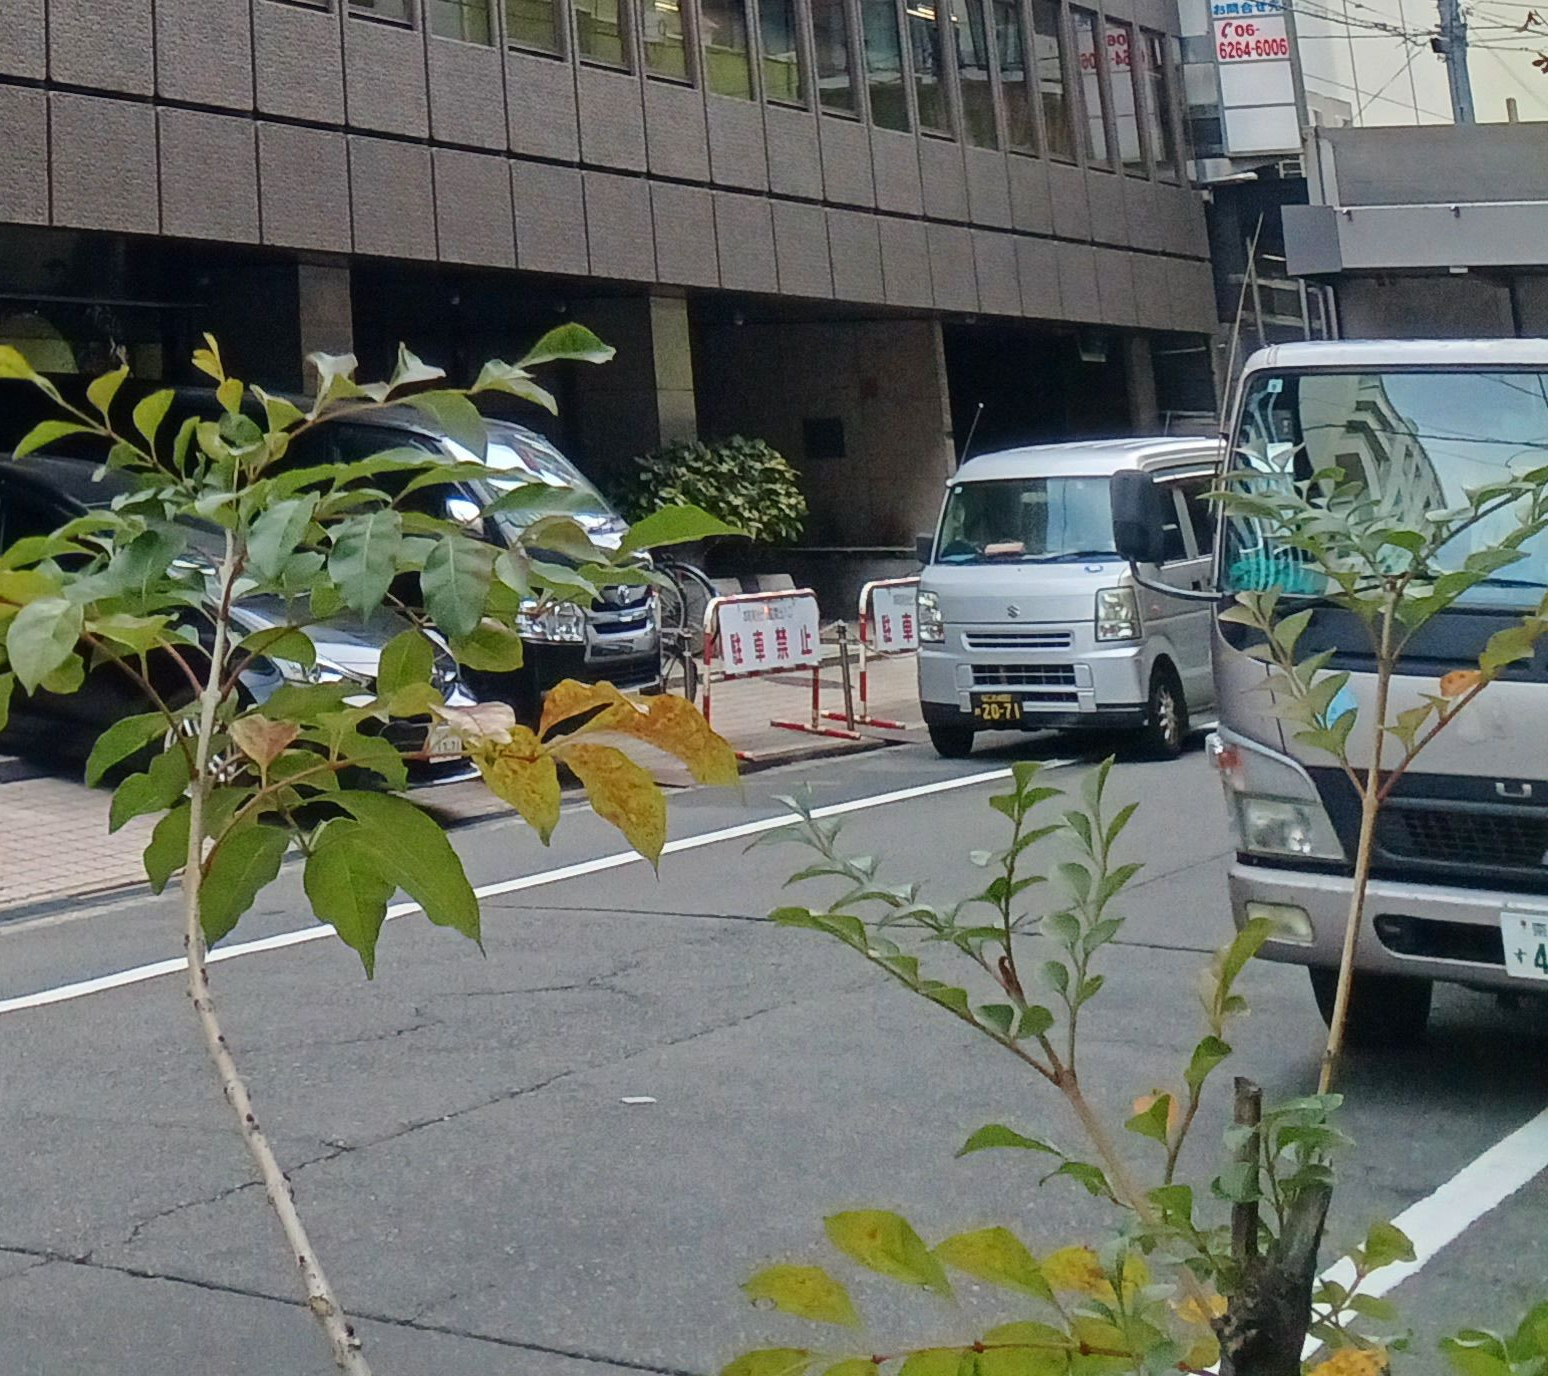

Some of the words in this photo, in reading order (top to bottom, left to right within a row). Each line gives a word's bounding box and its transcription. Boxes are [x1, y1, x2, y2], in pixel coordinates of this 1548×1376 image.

[1219, 38, 1288, 59] 6264-6006
[729, 623, 813, 666] 駐車禁止
